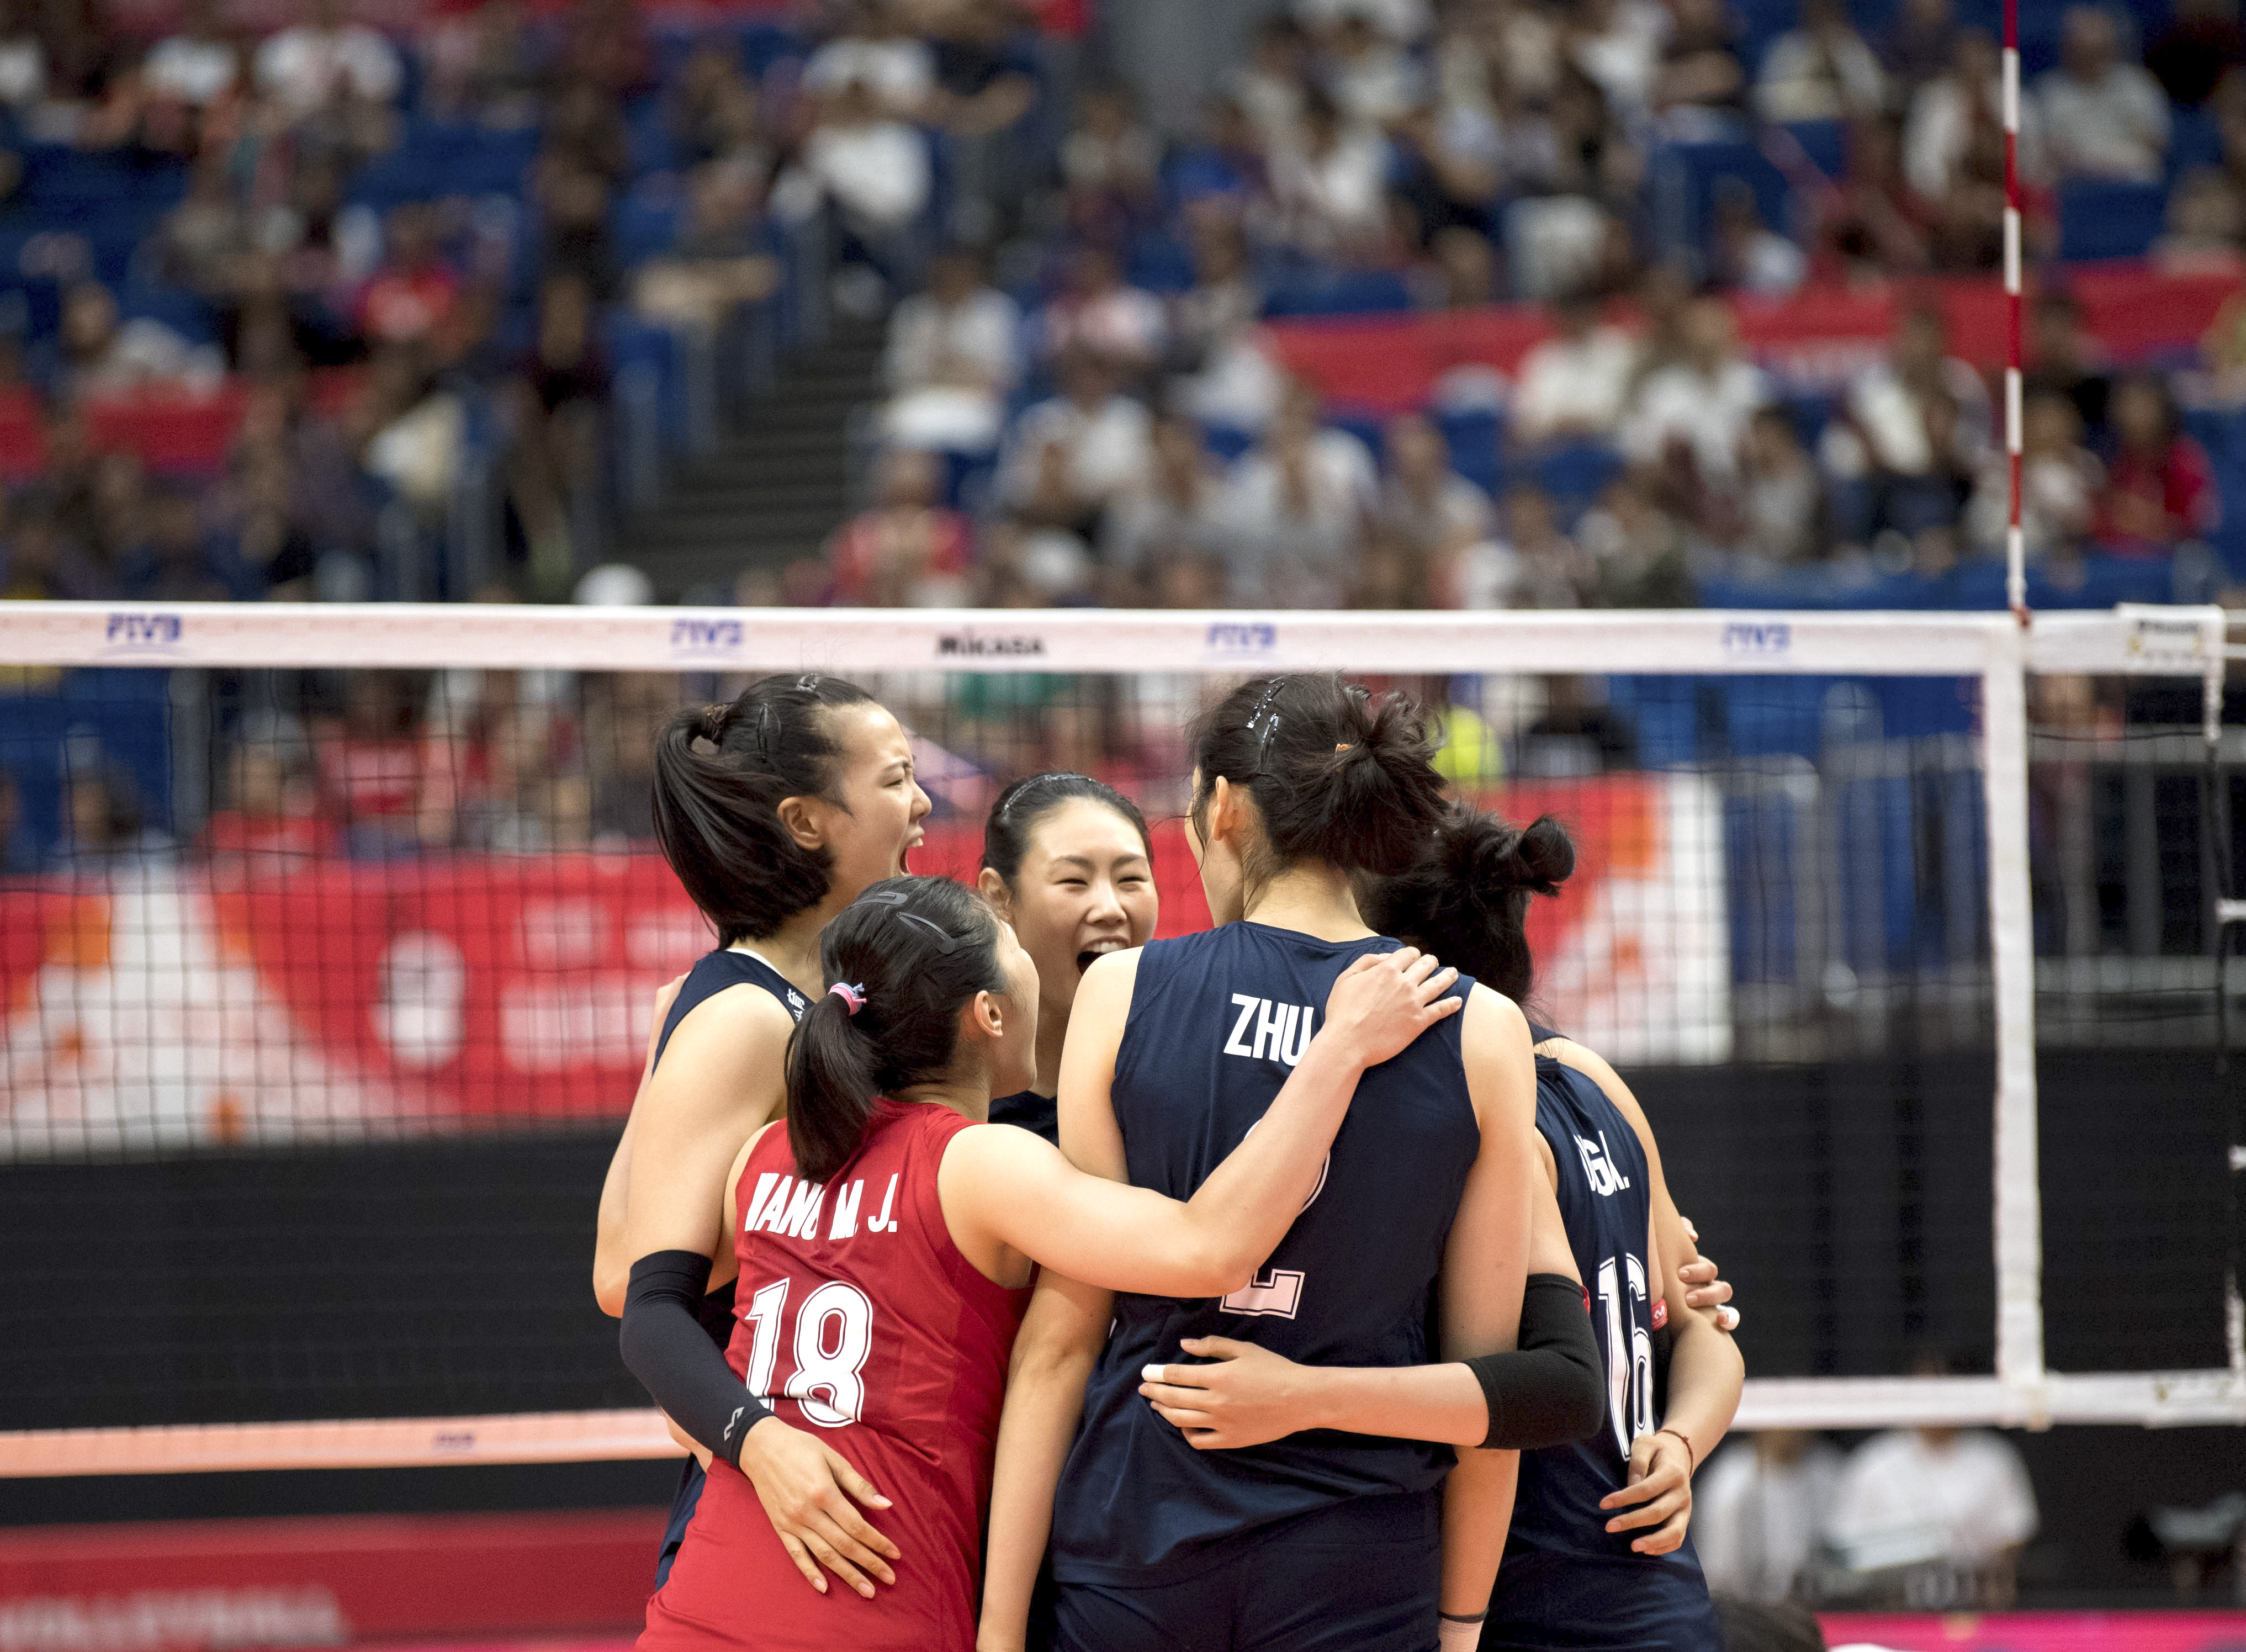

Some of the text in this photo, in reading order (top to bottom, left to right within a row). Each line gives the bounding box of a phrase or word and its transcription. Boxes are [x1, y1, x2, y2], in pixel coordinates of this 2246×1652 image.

[1223, 993, 1314, 1066] ZHU
[867, 1172, 899, 1233] J.
[744, 1277, 873, 1428] 18
[1598, 1253, 1655, 1462] 16
